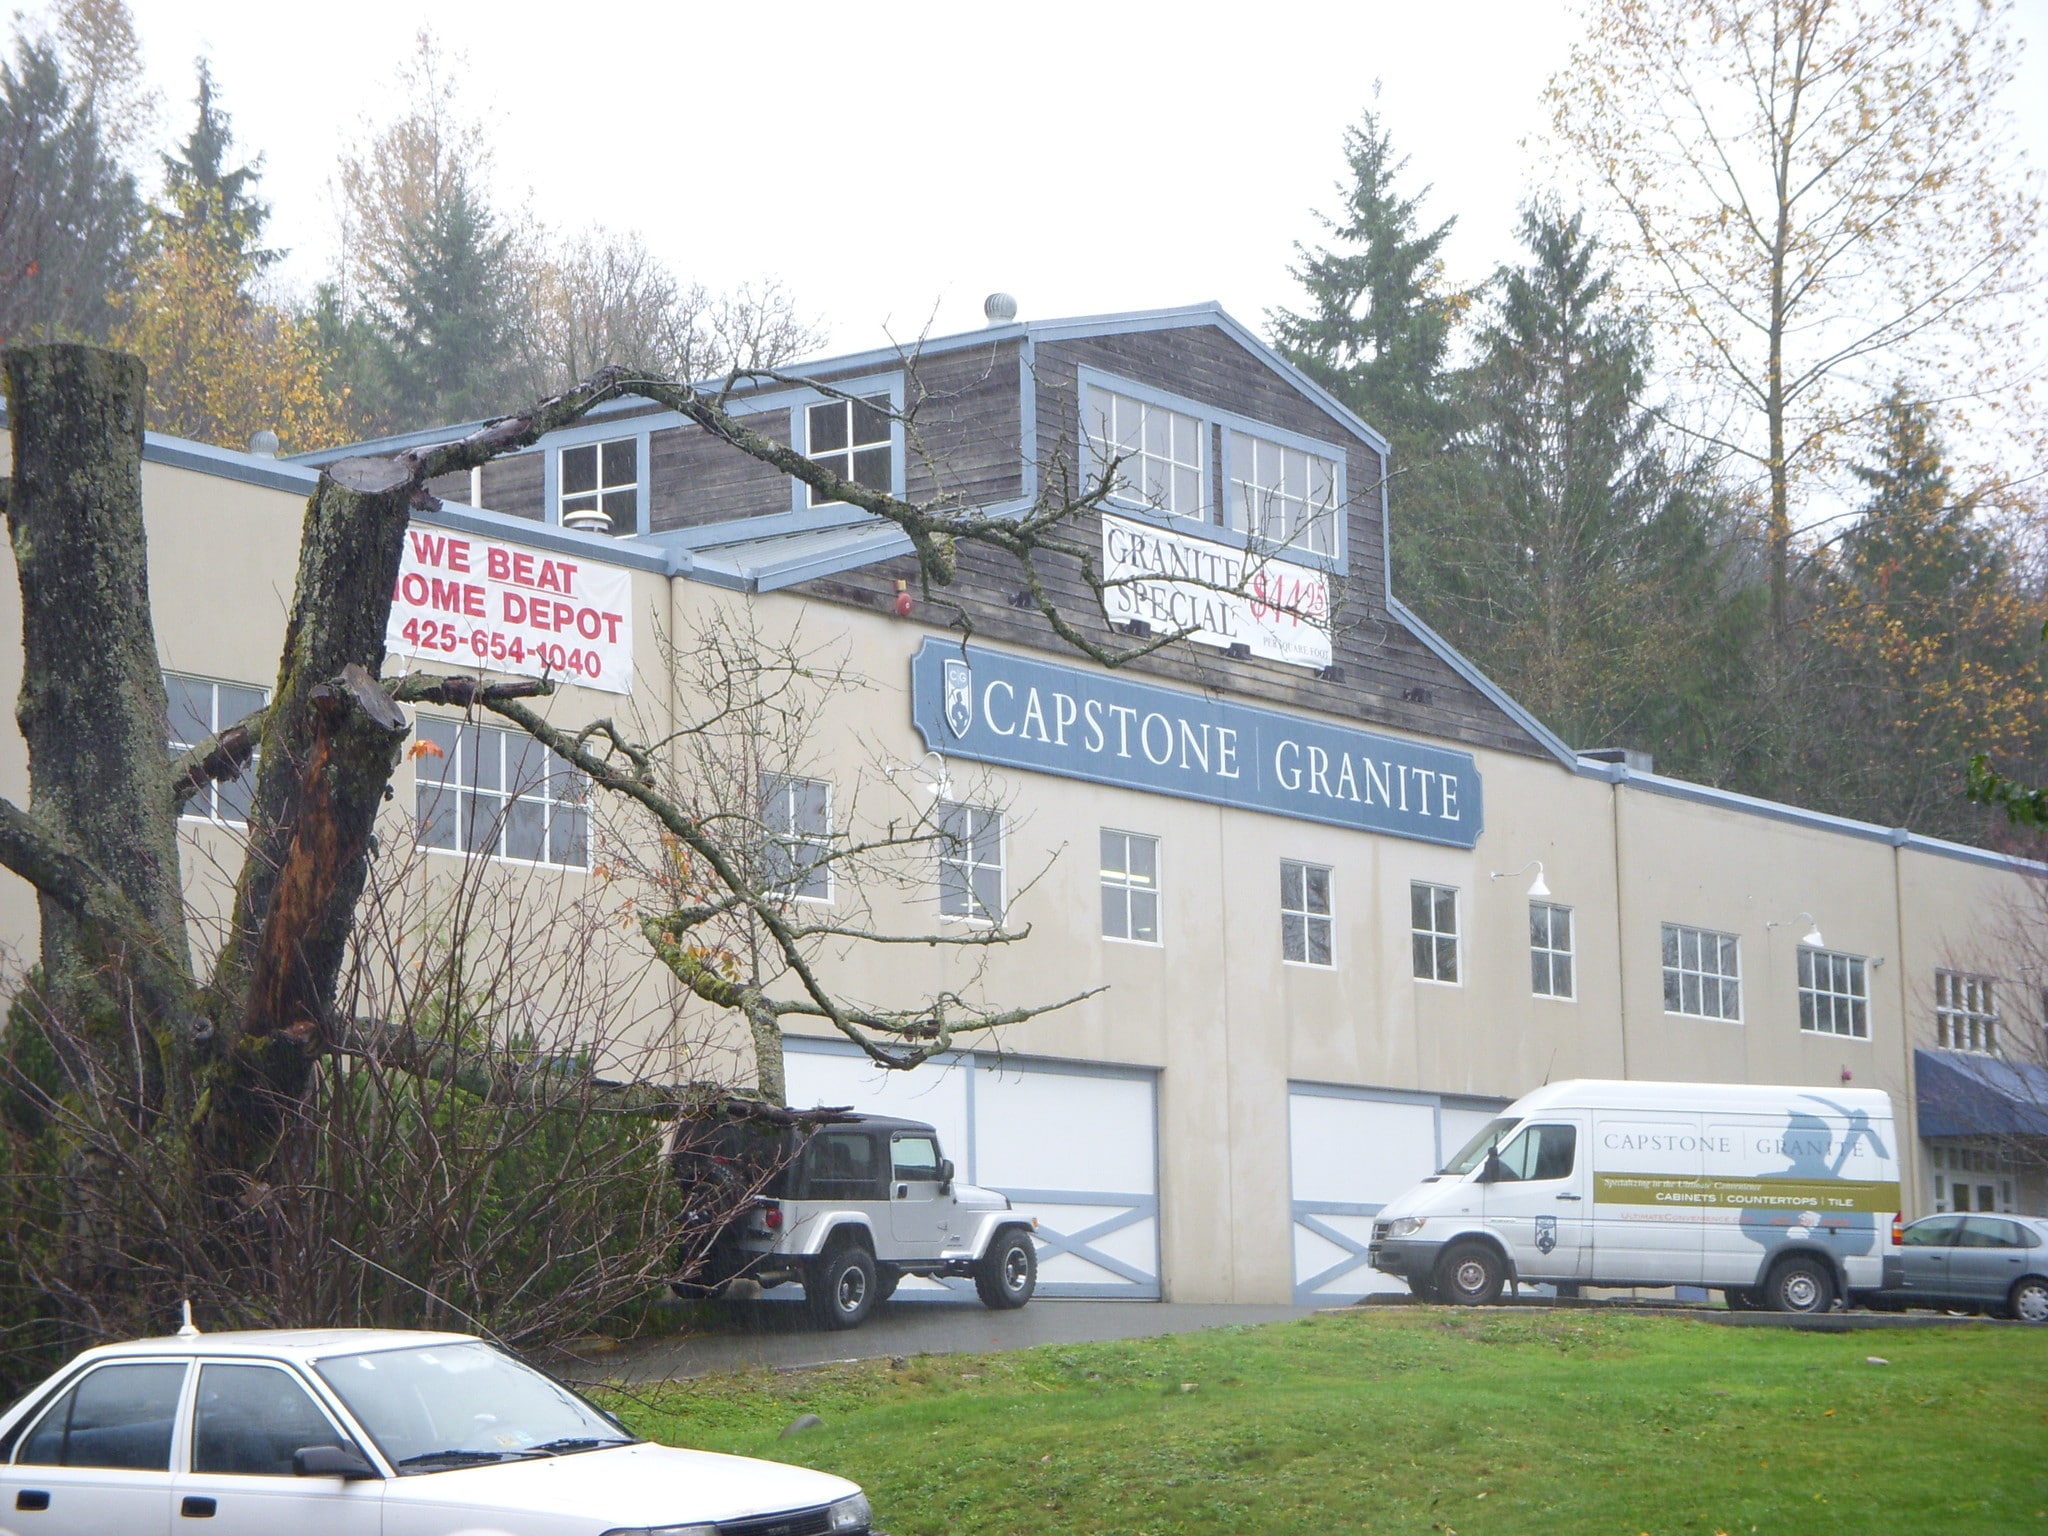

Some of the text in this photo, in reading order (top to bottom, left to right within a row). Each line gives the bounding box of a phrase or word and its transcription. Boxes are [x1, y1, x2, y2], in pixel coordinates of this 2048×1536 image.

[410, 531, 578, 594] WE BEAT
[1108, 528, 1240, 588] GRANITE
[392, 572, 623, 644] OME DEPOT
[1118, 582, 1238, 638] SPECIAL
[402, 617, 601, 679] 425-654-1040
[983, 680, 1460, 821] CAPSTONE GRANITE
[1604, 1133, 1864, 1158] CAPSTONE GRANITE
[1656, 1192, 1854, 1207] CABINETS COUNTERTOPS TILE
